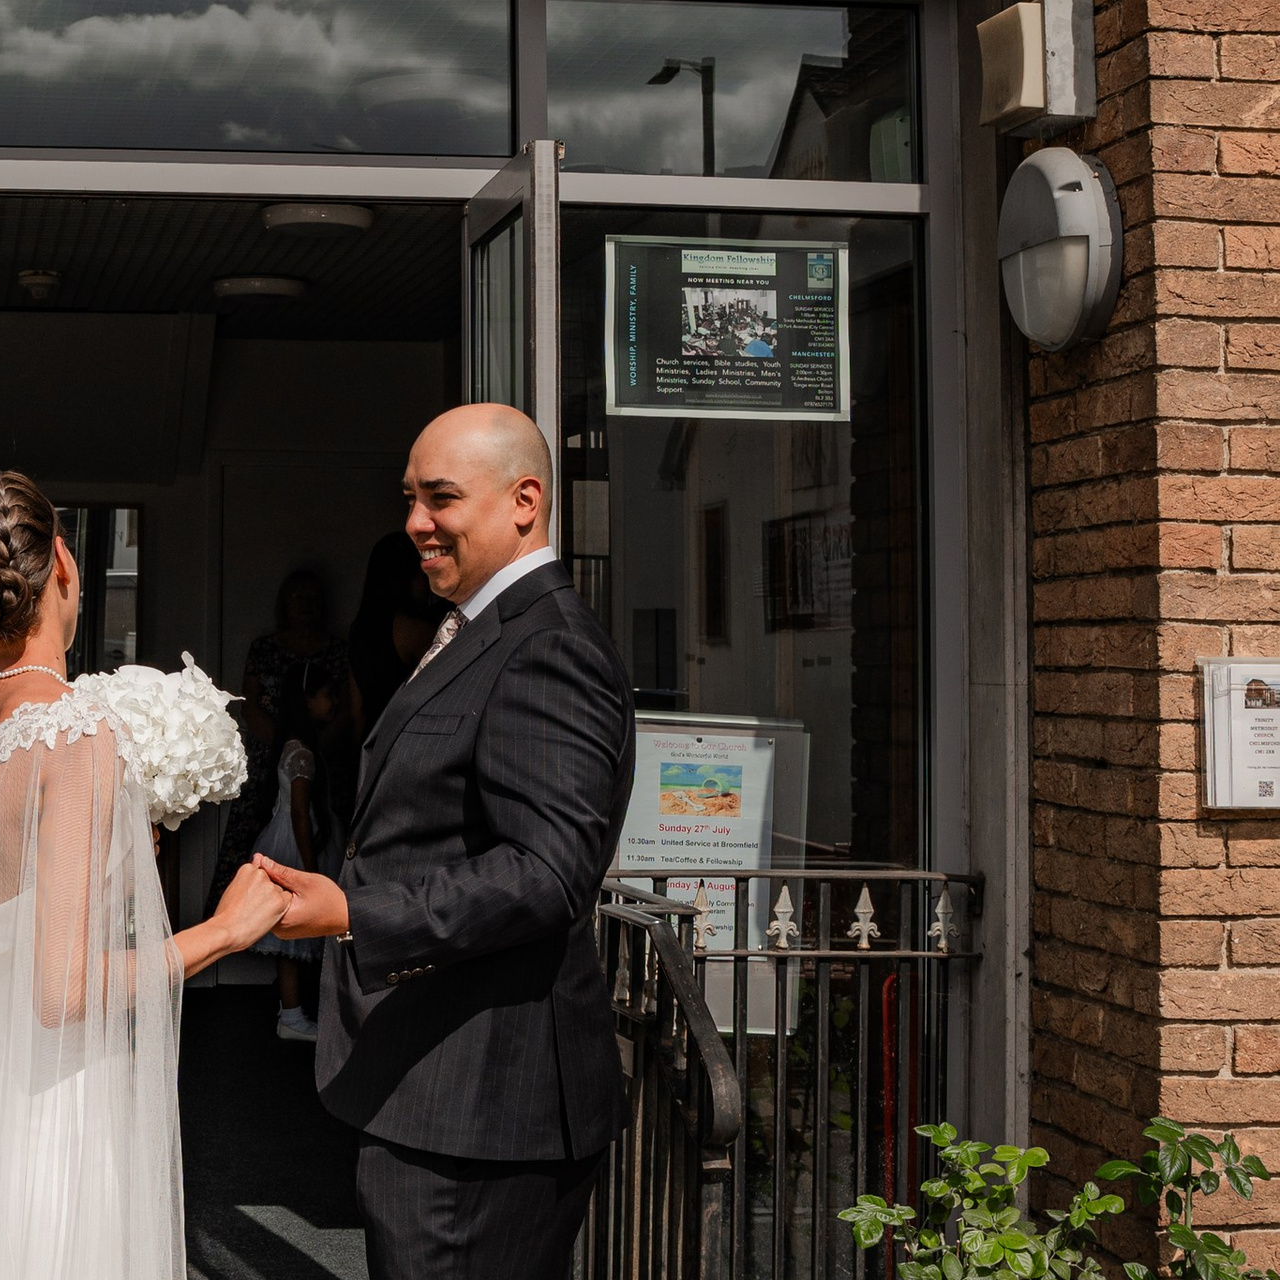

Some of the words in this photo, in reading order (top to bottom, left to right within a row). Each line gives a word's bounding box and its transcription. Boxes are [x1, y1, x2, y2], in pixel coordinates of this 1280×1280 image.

[683, 253, 724, 265] Kingdom
[705, 277, 735, 285] MEETING
[629, 298, 638, 342] MINISTRY,
[629, 345, 637, 387] WORSHIP,
[656, 357, 679, 366] Church
[683, 359, 711, 368] services,
[714, 359, 731, 367] Bible
[734, 360, 759, 369] studies,
[656, 367, 691, 376] Ministries,
[695, 368, 718, 376] Ladies
[722, 369, 757, 378] Ministries,
[760, 370, 782, 378] Men's
[656, 376, 689, 385] Ministries,
[691, 377, 716, 386] Sunday
[718, 378, 743, 387] School,
[744, 379, 782, 389] Community
[656, 385, 685, 395] Support.
[653, 739, 690, 749] Welcome
[717, 742, 747, 752] Church
[686, 752, 712, 760] Wonderful
[658, 823, 692, 834] Sunday
[712, 826, 731, 836] July
[627, 837, 656, 845] 10.30am
[685, 840, 711, 848] Service
[721, 840, 759, 849] Broomfield
[627, 854, 655, 862] 11.30am
[660, 855, 698, 864] Tea/Coffee
[705, 858, 743, 867] Fellowship
[667, 880, 691, 891] unday
[707, 881, 736, 892] Augus
